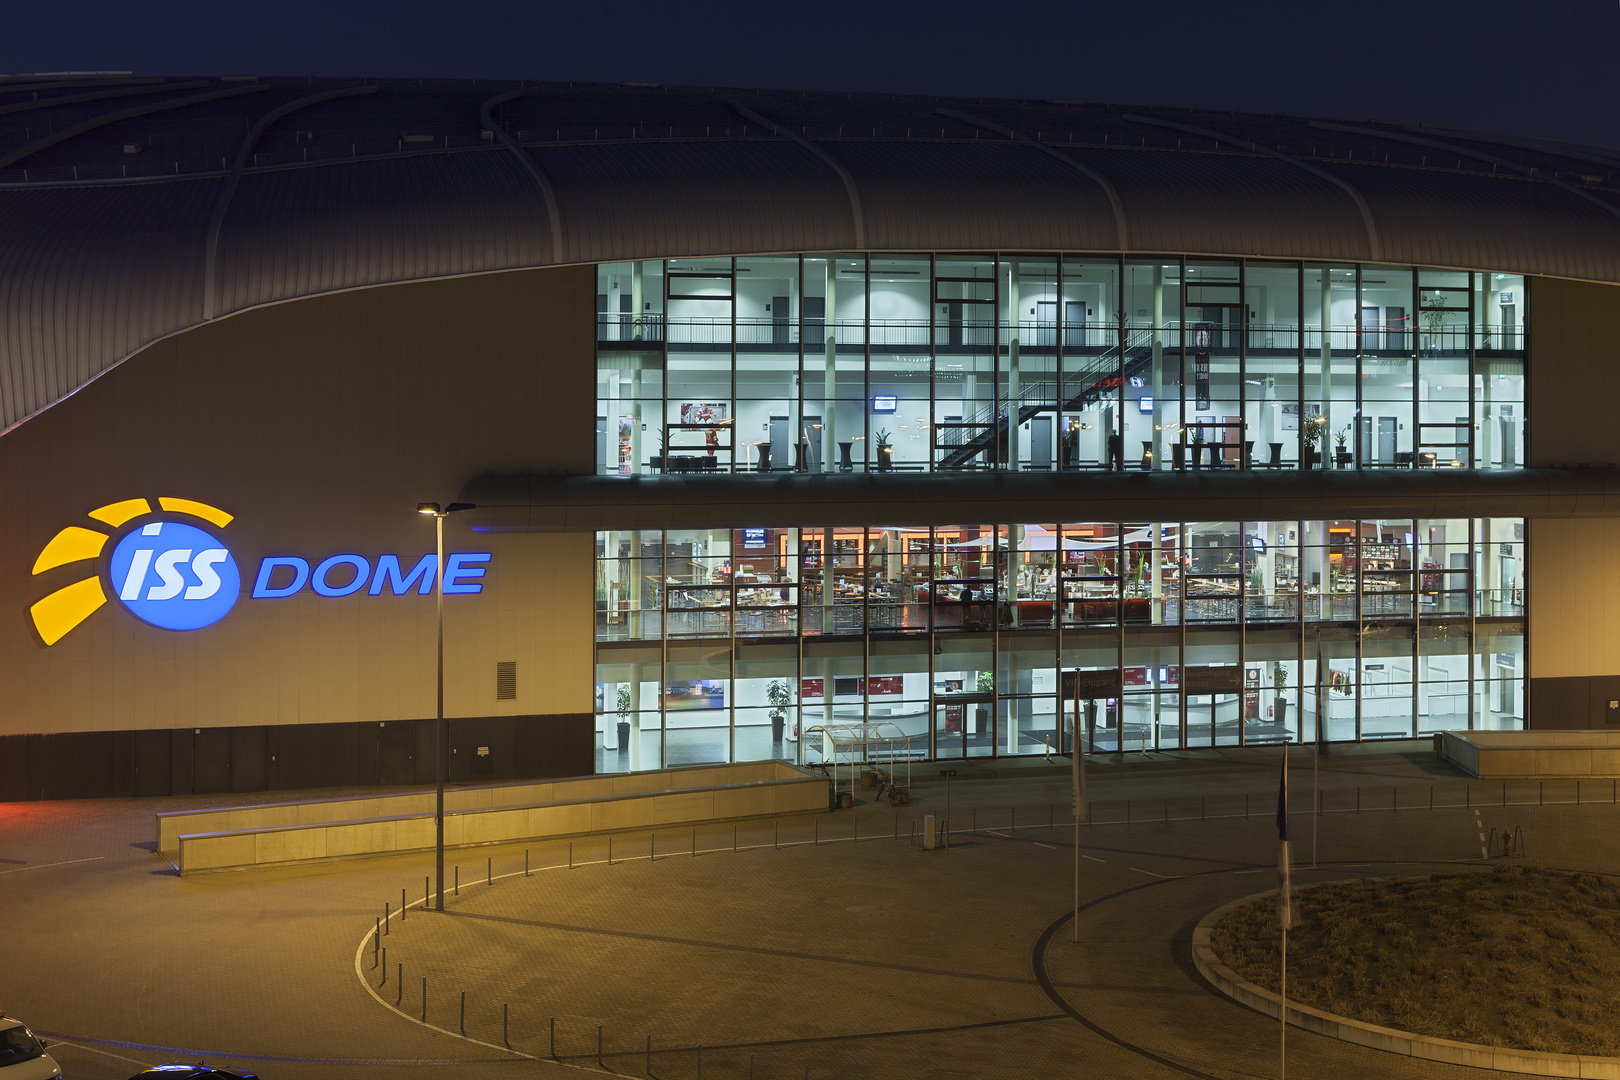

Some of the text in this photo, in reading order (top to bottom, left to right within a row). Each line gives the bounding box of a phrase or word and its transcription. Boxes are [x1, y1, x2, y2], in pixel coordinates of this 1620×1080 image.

[250, 552, 492, 599] DOME
[1186, 670, 1231, 678] Haupteingang
[1065, 677, 1117, 688] VI-Eingang
[1186, 680, 1209, 688] Kassen
